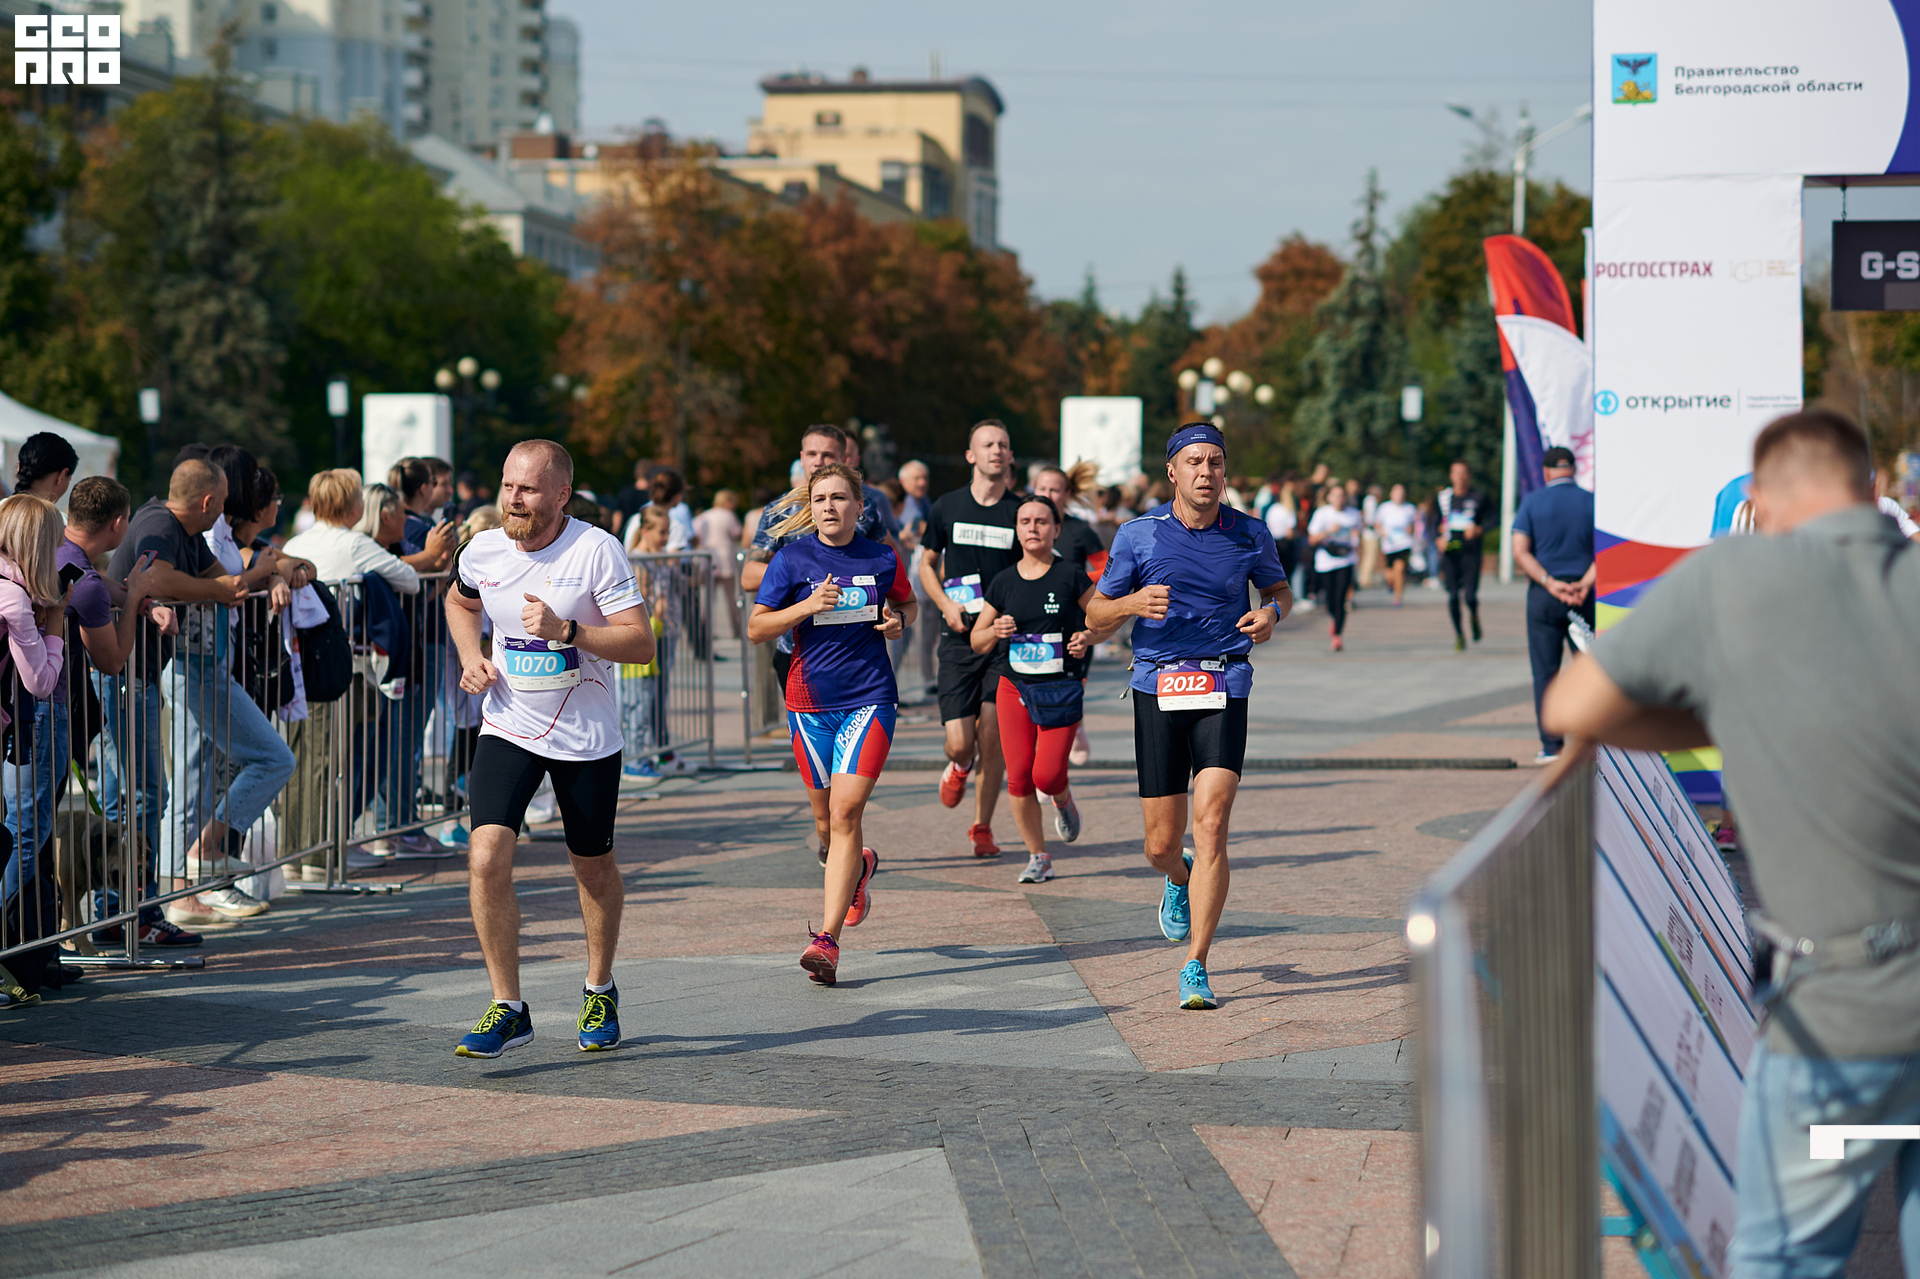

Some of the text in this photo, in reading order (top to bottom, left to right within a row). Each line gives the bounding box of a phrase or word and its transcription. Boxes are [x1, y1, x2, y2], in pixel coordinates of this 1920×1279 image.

[1674, 64, 1799, 79] Правительство
[1674, 80, 1863, 96] Белгородской области
[1595, 261, 1713, 278] РОСГОССТРАХ
[1860, 251, 1920, 279] G-S
[1626, 394, 1732, 413] открытие
[958, 529, 974, 539] JUST
[1017, 646, 1047, 660] 1219
[514, 655, 558, 673] 1070
[1162, 675, 1208, 693] 2012
